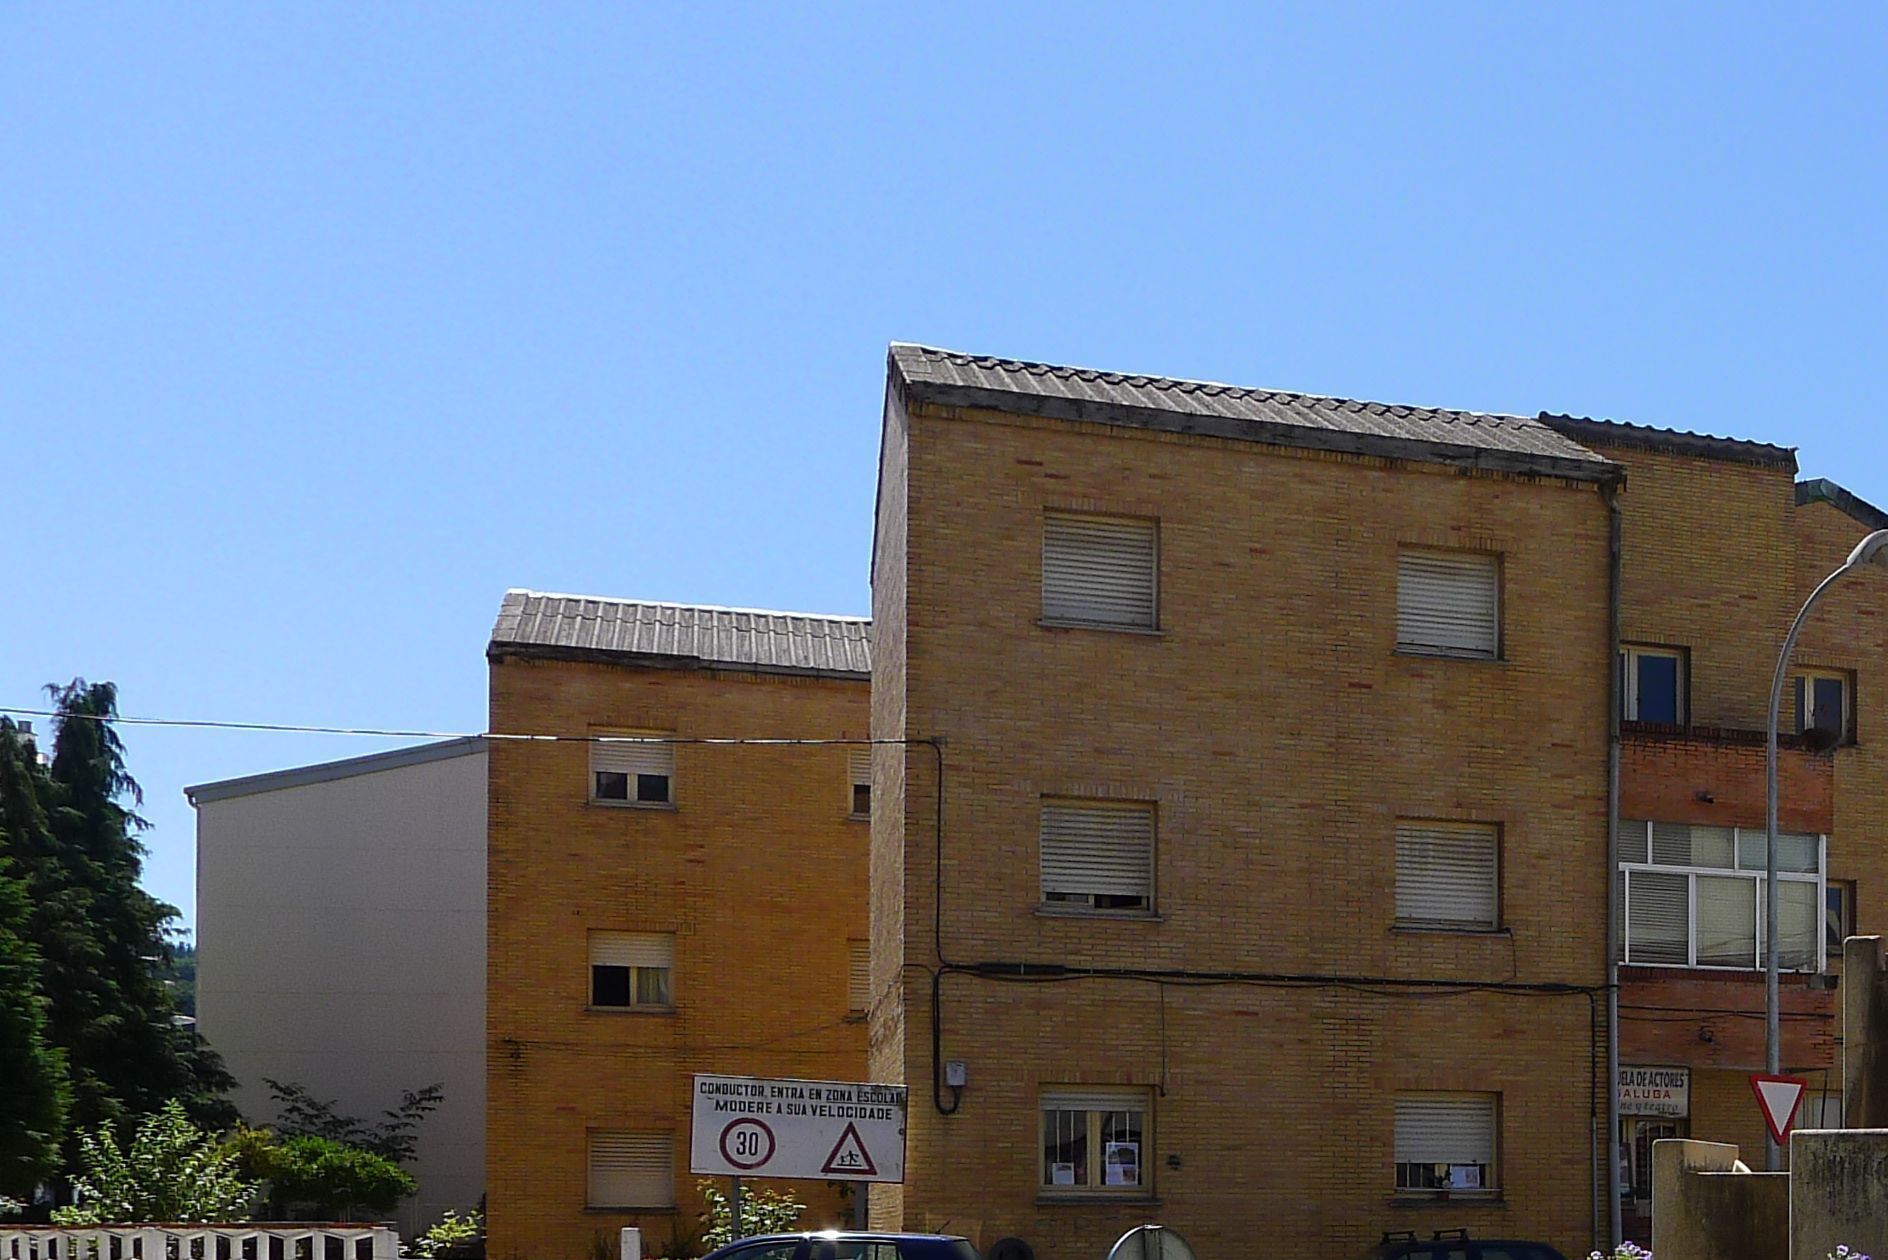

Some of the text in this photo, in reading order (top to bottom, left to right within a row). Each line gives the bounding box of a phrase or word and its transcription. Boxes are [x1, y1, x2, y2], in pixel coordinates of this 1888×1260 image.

[1637, 1071, 1647, 1087] DE
[1648, 1071, 1684, 1088] ACTORES
[700, 1082, 767, 1099] CONDUCTOR,
[771, 1086, 804, 1100] ENTRA
[809, 1088, 822, 1101] EN
[826, 1089, 852, 1102] ZONA
[715, 1099, 892, 1120] MODERE A SUA VELOCIDADE
[736, 1131, 759, 1156] 30
